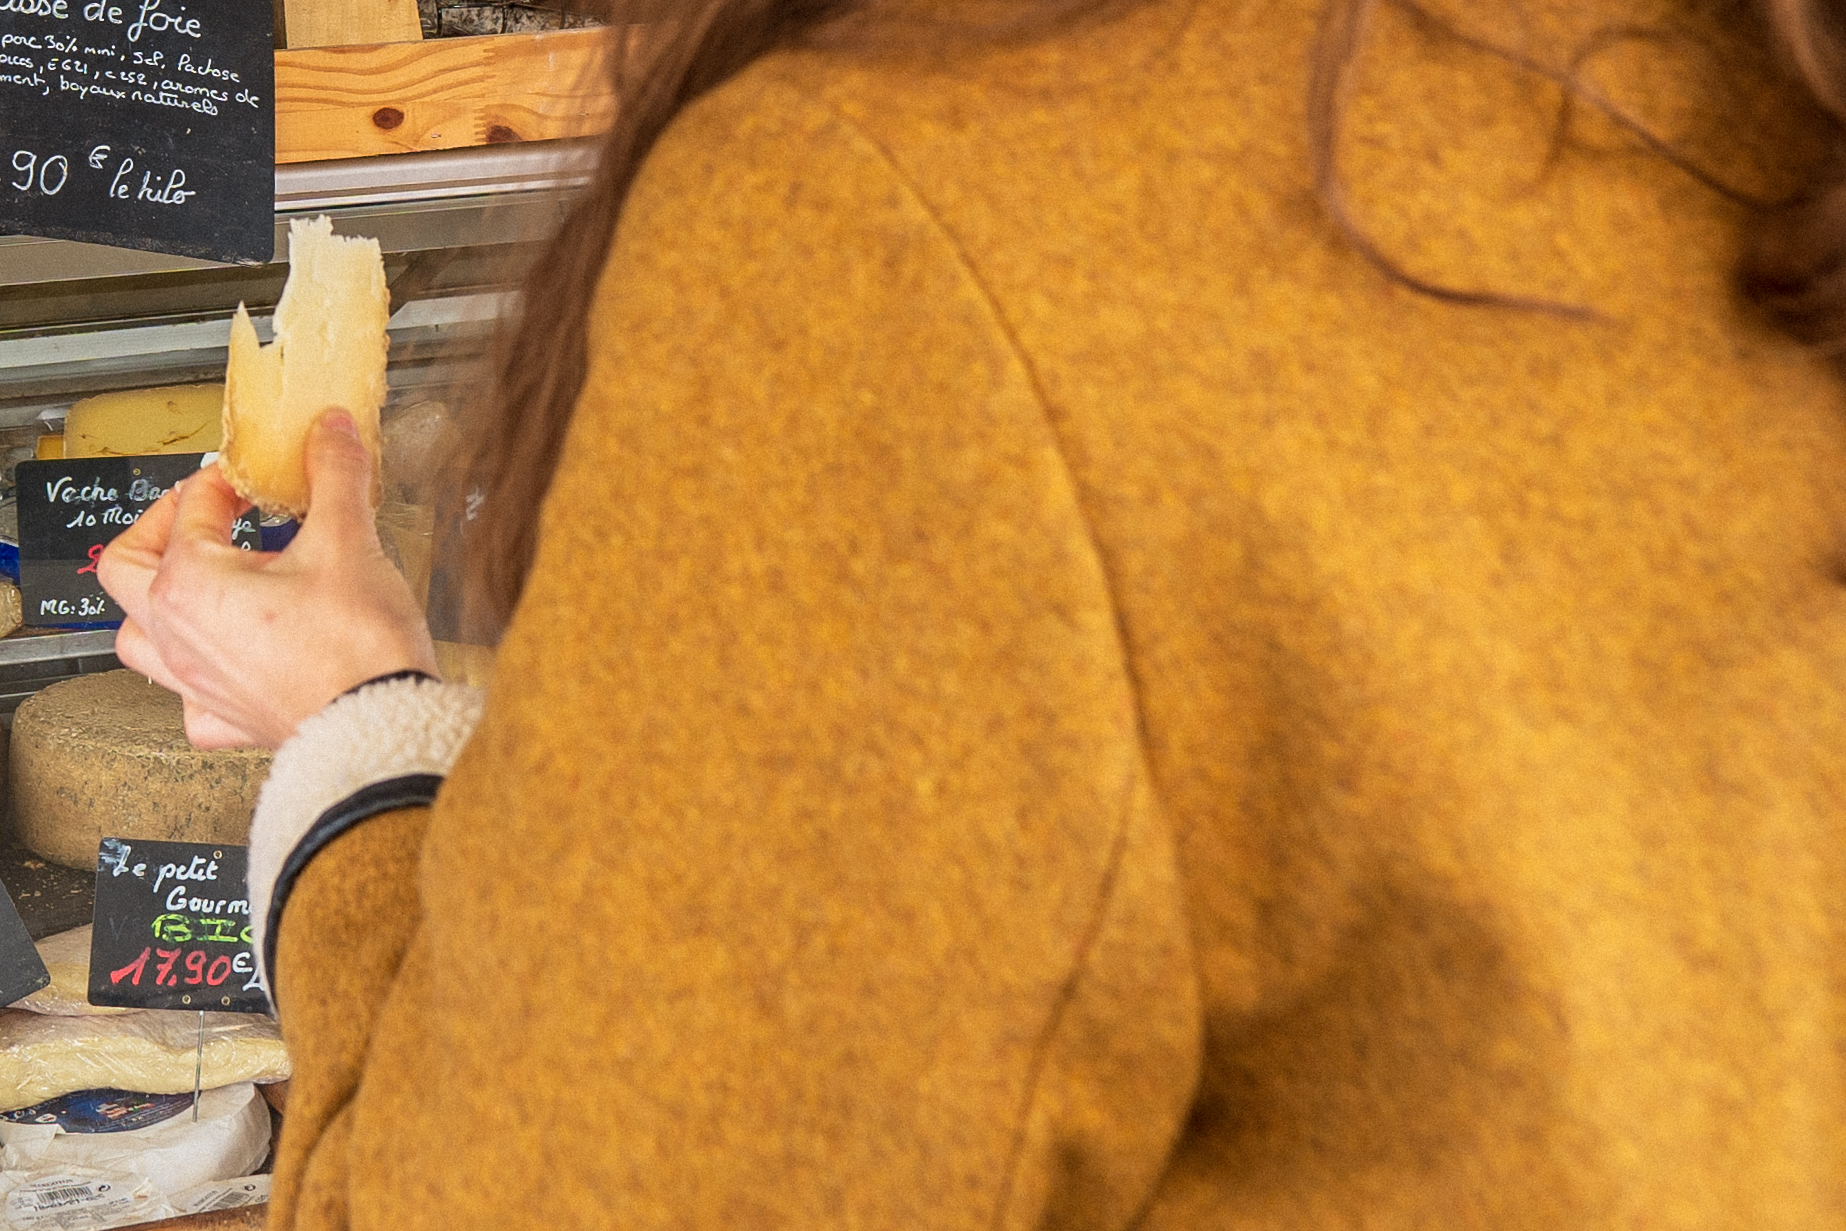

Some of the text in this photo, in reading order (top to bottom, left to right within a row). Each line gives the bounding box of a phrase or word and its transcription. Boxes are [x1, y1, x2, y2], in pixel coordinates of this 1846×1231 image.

[2, 30, 42, 51] porc
[45, 33, 77, 53] 30%
[60, 77, 126, 105] boyaux
[235, 89, 260, 109] de
[66, 507, 144, 528] 10 Moi
[40, 599, 75, 616] MG:
[152, 855, 219, 893] petit
